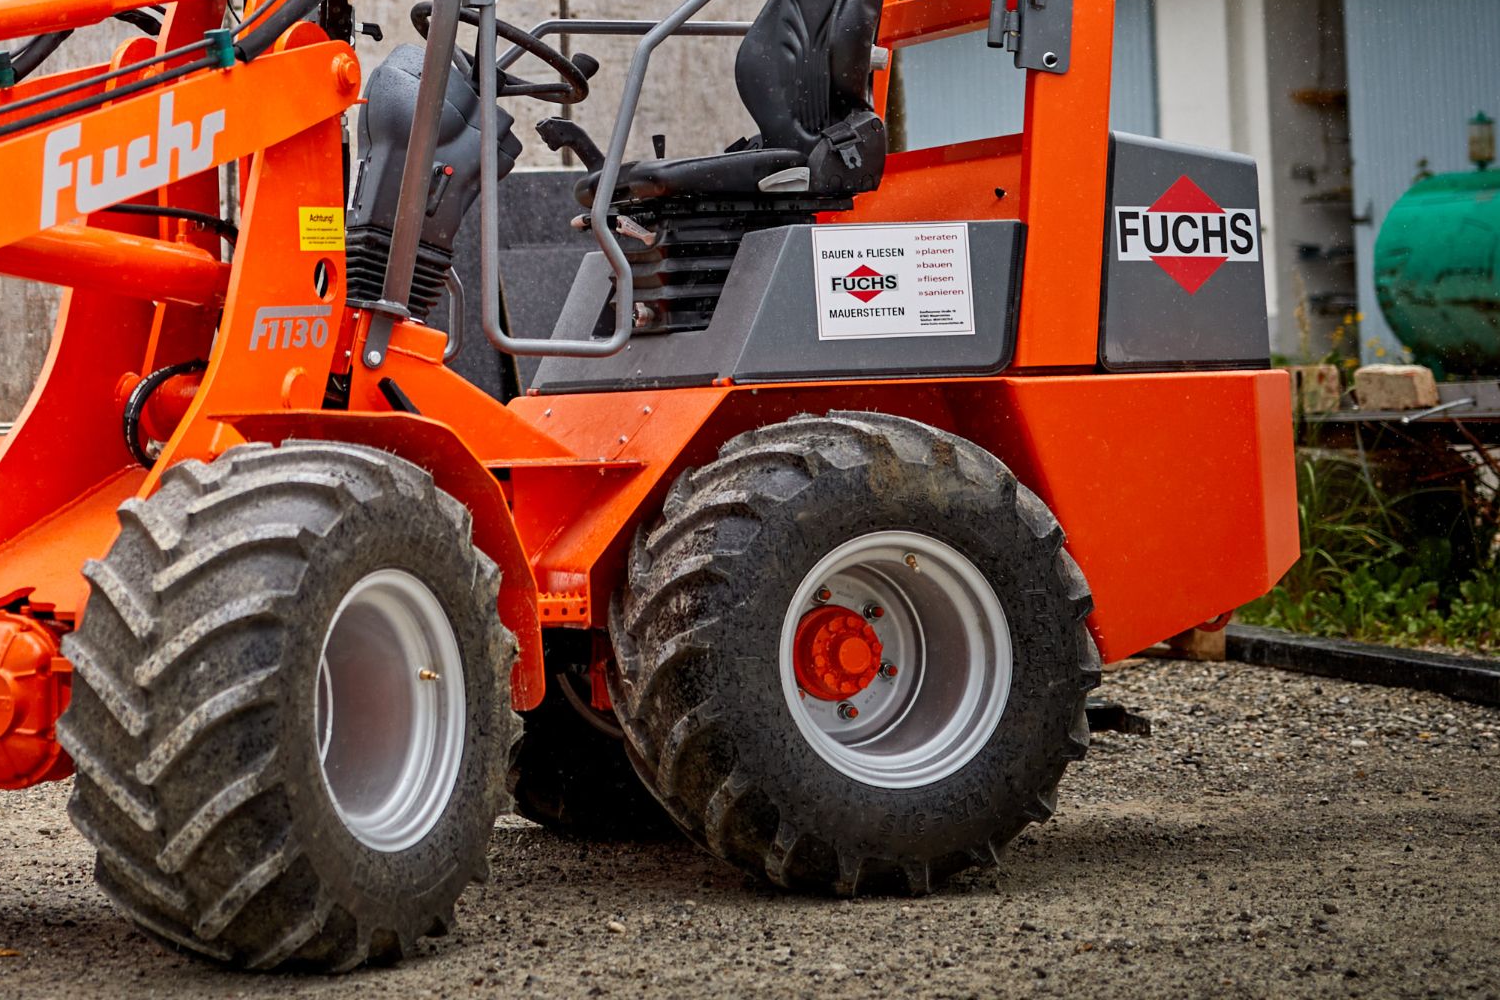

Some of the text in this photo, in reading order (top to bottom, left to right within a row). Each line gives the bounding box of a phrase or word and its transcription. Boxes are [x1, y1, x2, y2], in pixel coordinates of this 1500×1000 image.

[40, 90, 225, 231] Fuchs
[1118, 211, 1254, 255] FUCHS
[821, 249, 854, 260] BAUEN
[866, 248, 904, 258] FLIESEN
[831, 275, 898, 291] FUCHS
[829, 307, 905, 318] MAUERSTETTEN
[248, 305, 333, 351] F1130
